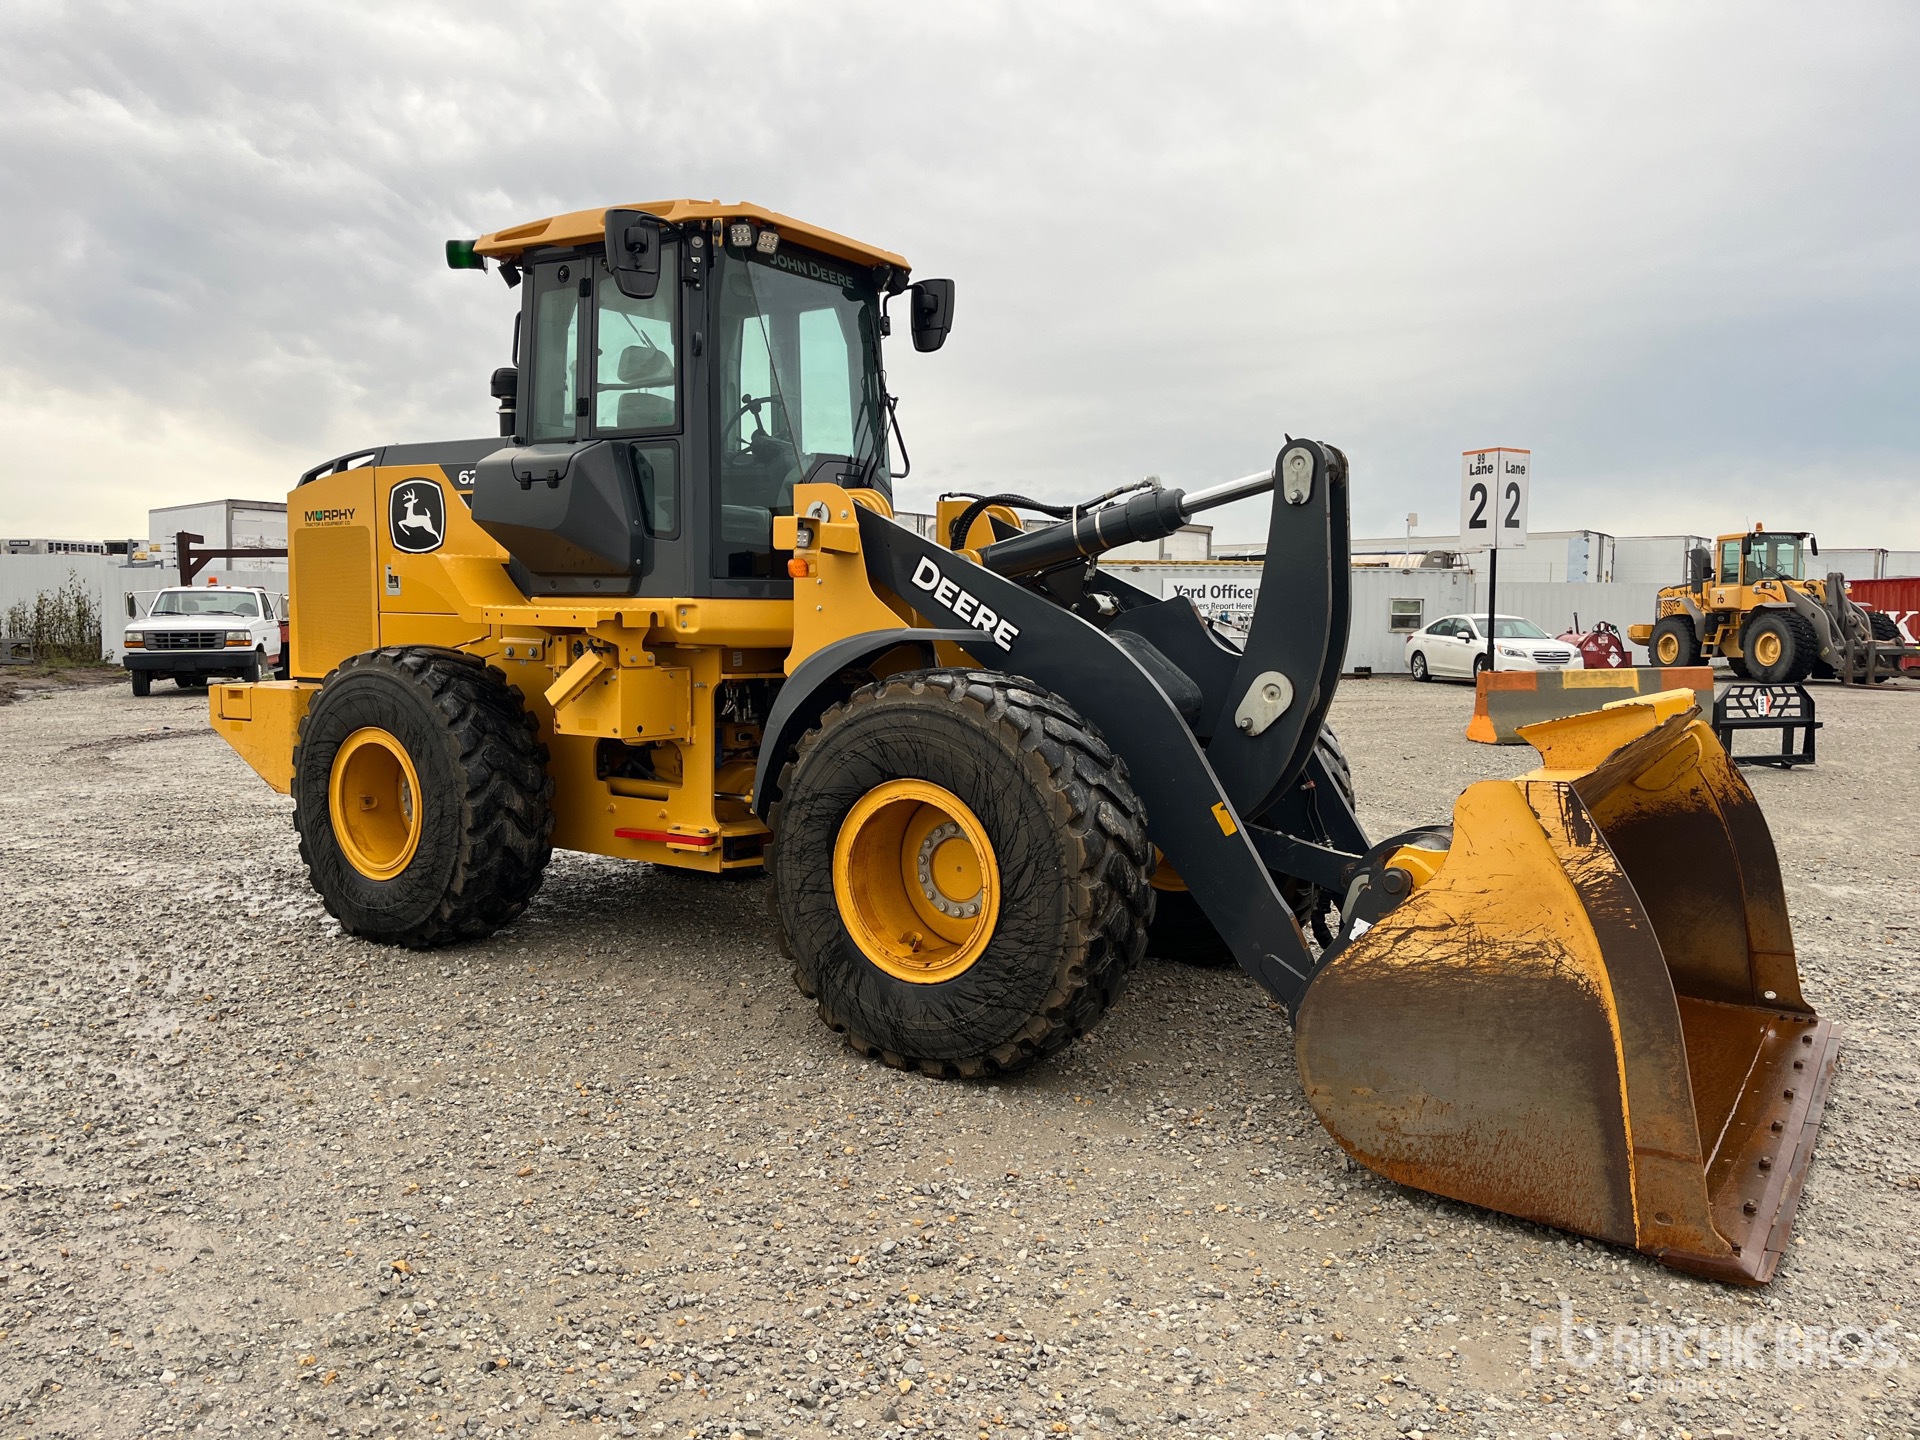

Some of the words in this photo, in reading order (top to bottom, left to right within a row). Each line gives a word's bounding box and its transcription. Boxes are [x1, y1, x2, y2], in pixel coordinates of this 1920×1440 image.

[770, 254, 808, 275] JOHN
[809, 261, 854, 289] DEERE
[1469, 463, 1494, 476] Lane
[1505, 461, 1526, 475] Lane
[1469, 482, 1488, 529] 2
[1504, 481, 1521, 528] 2
[304, 508, 356, 521] MURPHY
[1173, 584, 1206, 599] Yard
[1210, 584, 1253, 599] Office
[911, 555, 1020, 652] DEERE
[1211, 602, 1235, 611] Report
[1236, 602, 1253, 610] Here
